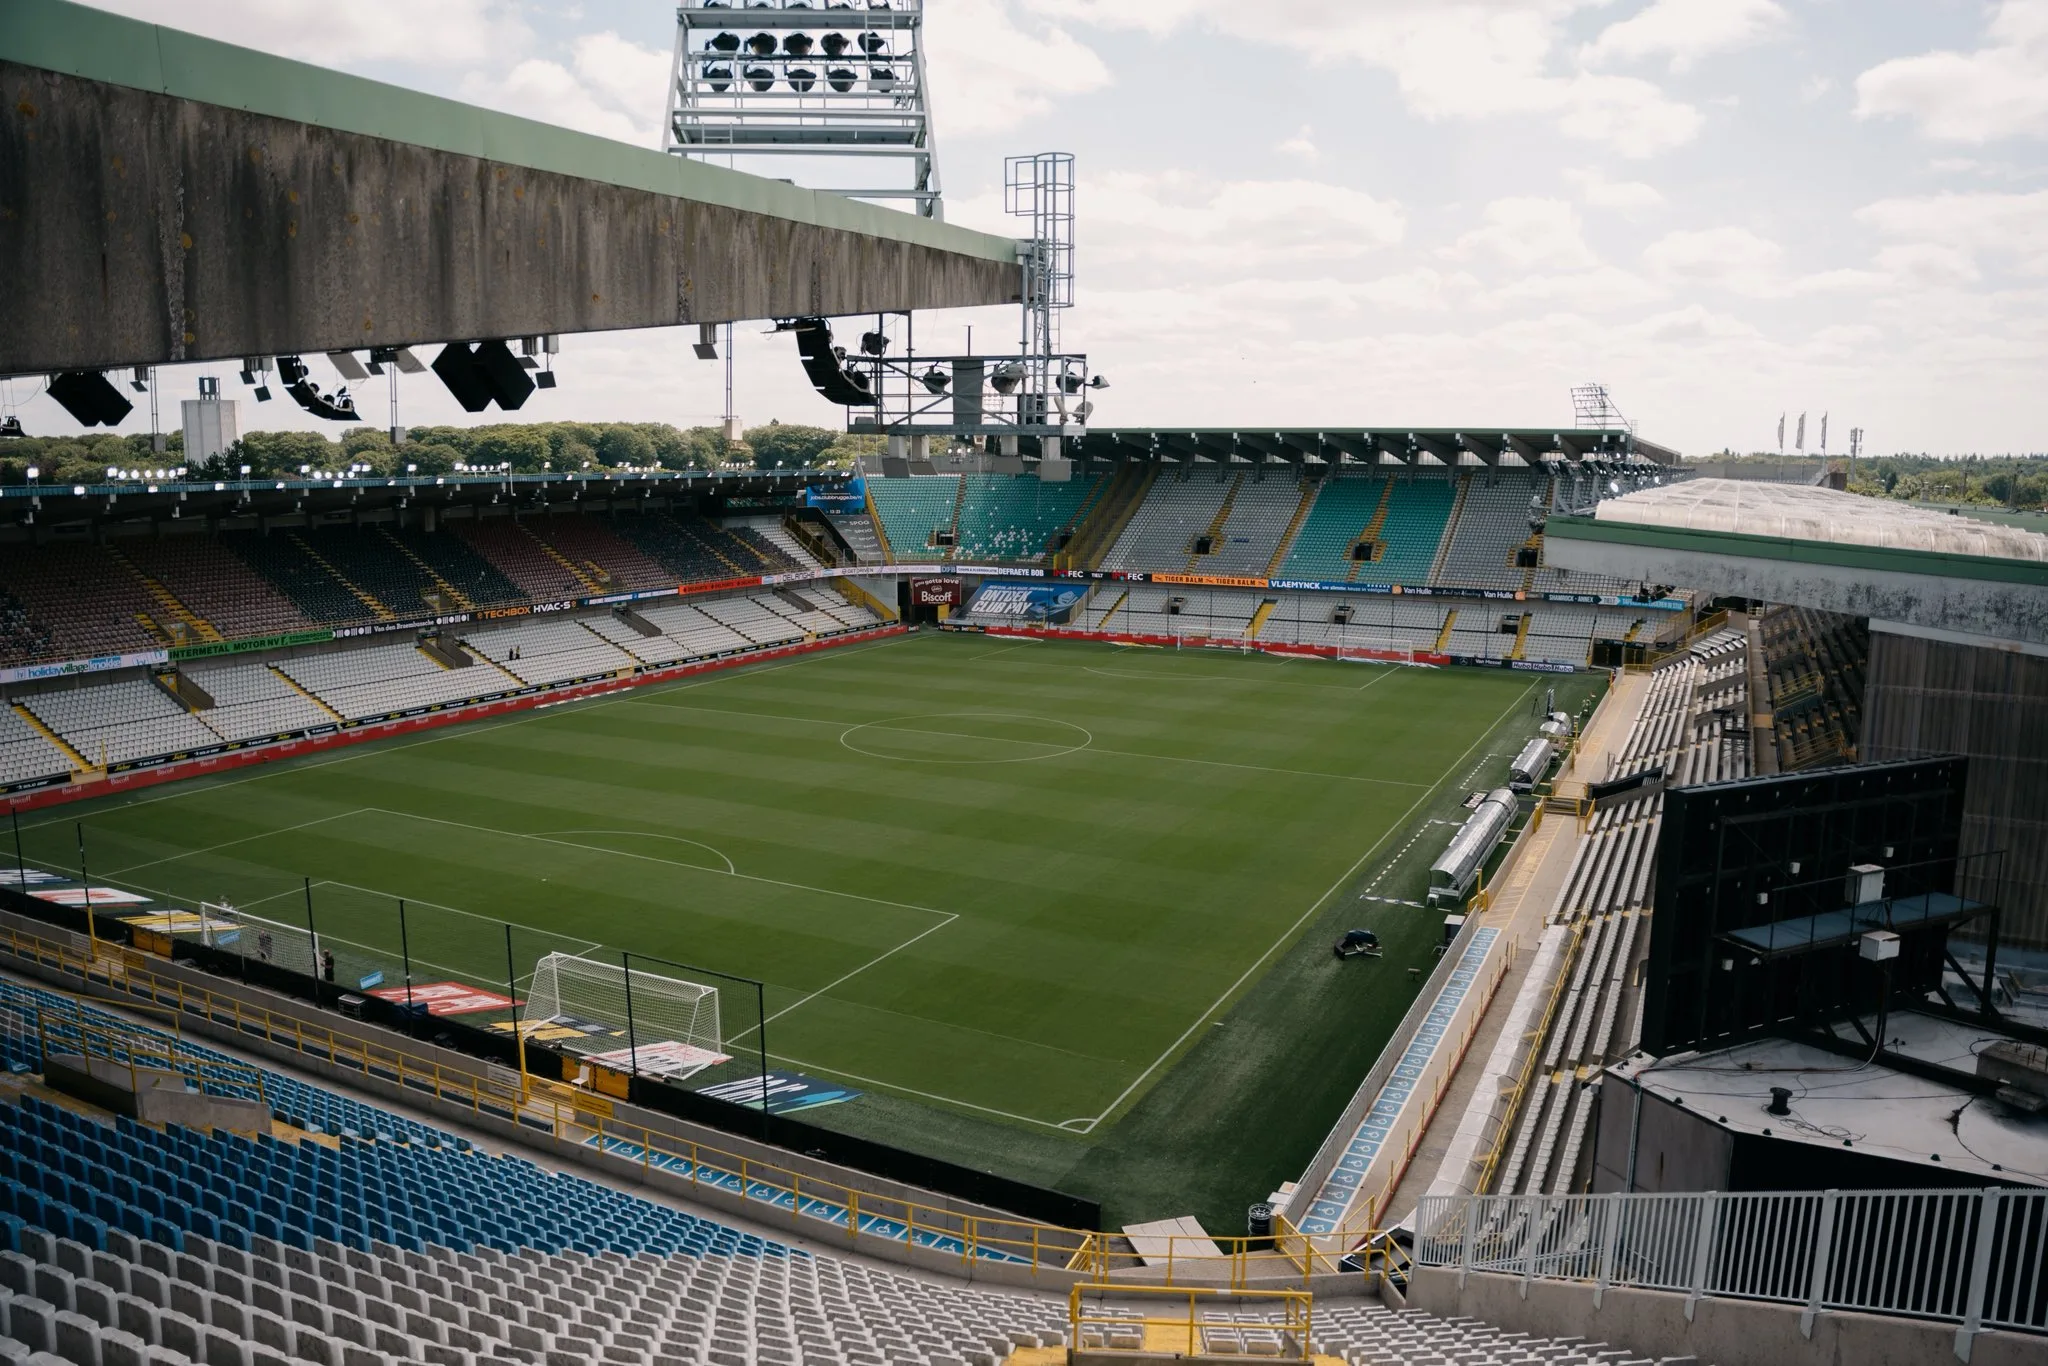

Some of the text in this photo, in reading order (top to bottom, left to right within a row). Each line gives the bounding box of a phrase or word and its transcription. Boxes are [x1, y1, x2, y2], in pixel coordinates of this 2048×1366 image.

[998, 567, 1044, 576] DEFRAEYE BOB
[1271, 580, 1320, 590] VLAEMYNCK
[922, 591, 952, 602] Biscoff
[980, 590, 1032, 602] ONTDEK
[1404, 587, 1416, 595] Van
[484, 606, 531, 619] TECHBOX
[972, 601, 1032, 614] CLUB PAY
[170, 646, 230, 659] INTERMETAL
[233, 640, 266, 651] MOTOR
[268, 638, 280, 646] NV
